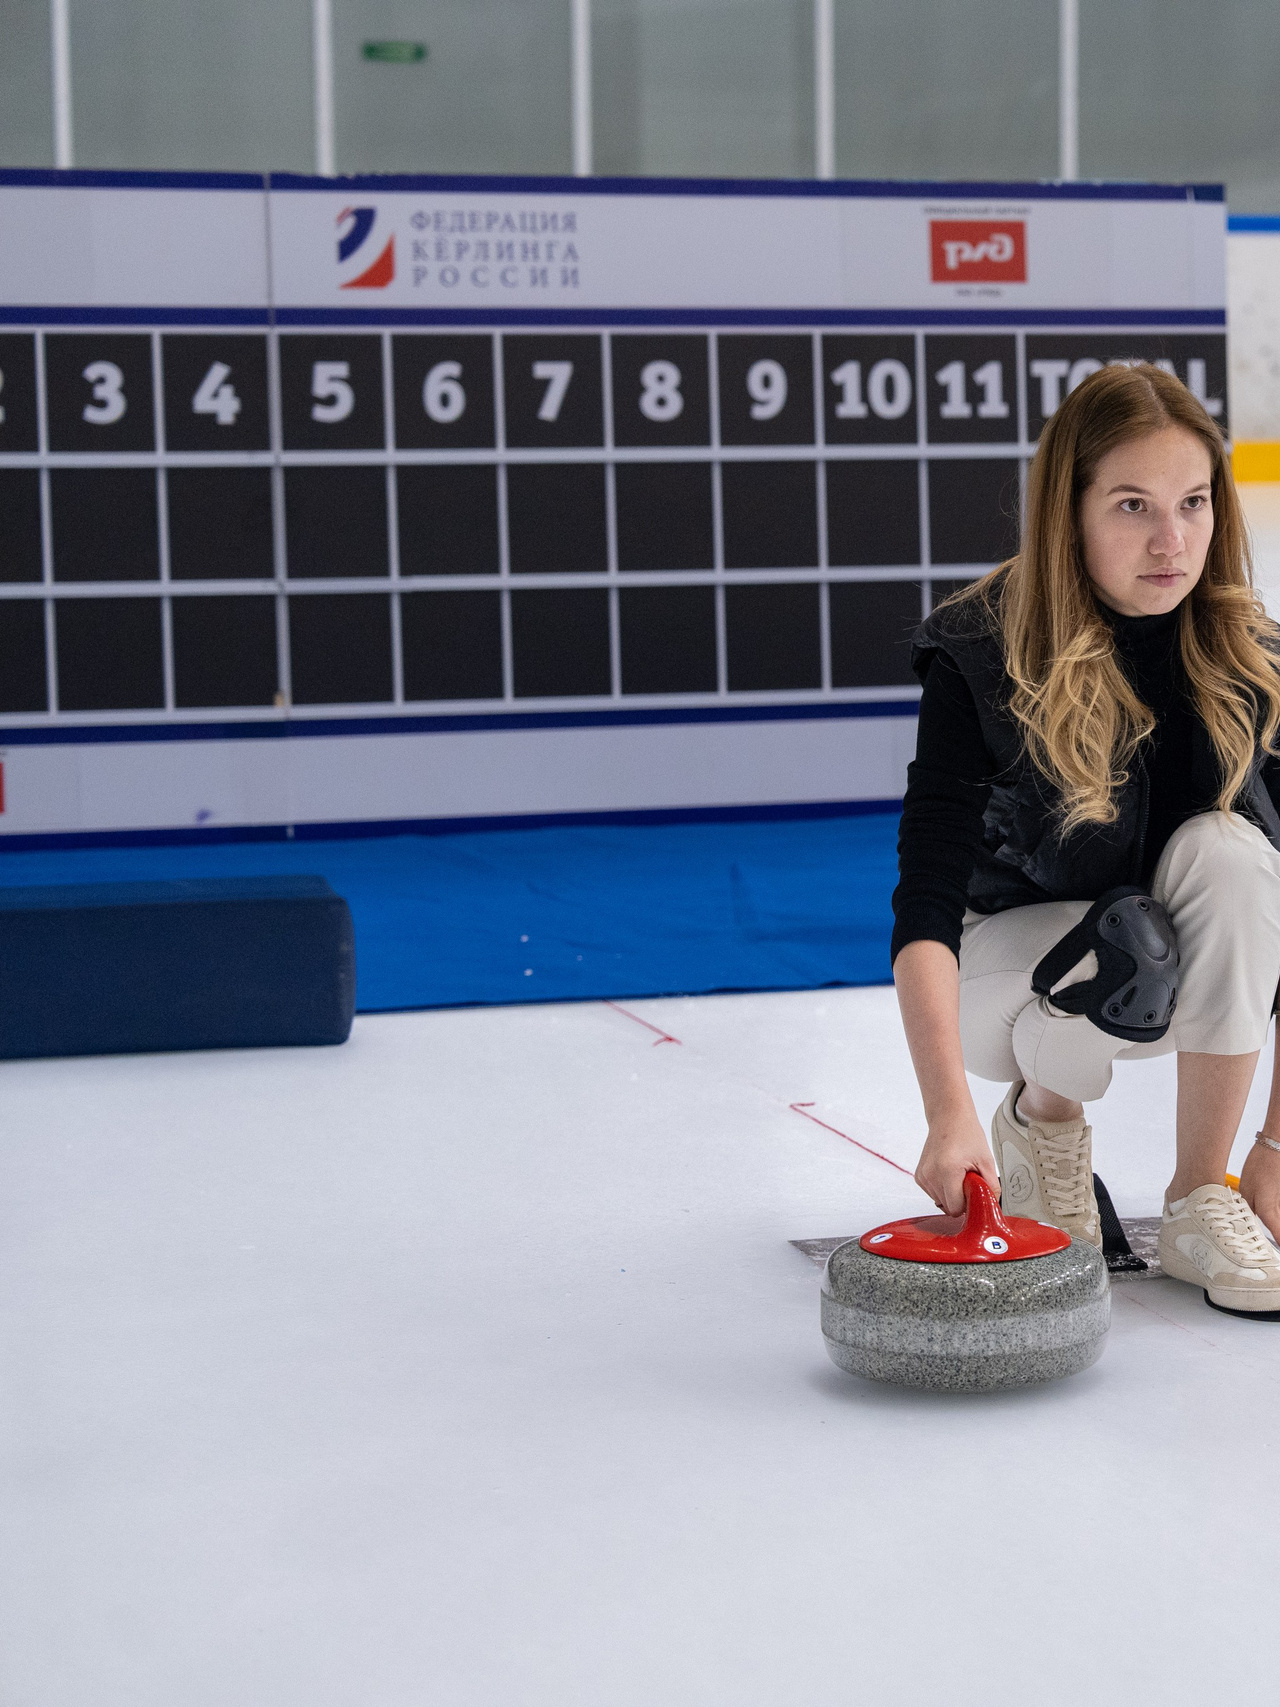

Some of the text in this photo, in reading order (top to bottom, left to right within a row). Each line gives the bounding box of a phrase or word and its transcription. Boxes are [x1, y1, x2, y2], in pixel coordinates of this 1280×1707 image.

[409, 210, 578, 233] ФЕДЕРАЦИЯ
[411, 265, 580, 289] РОССИИ
[82, 361, 127, 425] 3
[193, 361, 241, 425] 4
[311, 361, 355, 423] 5
[422, 361, 466, 423] 6
[531, 361, 573, 421] 7
[639, 359, 684, 422] 8
[746, 359, 788, 420] 9
[831, 359, 912, 419] 10
[935, 360, 1010, 419] 11
